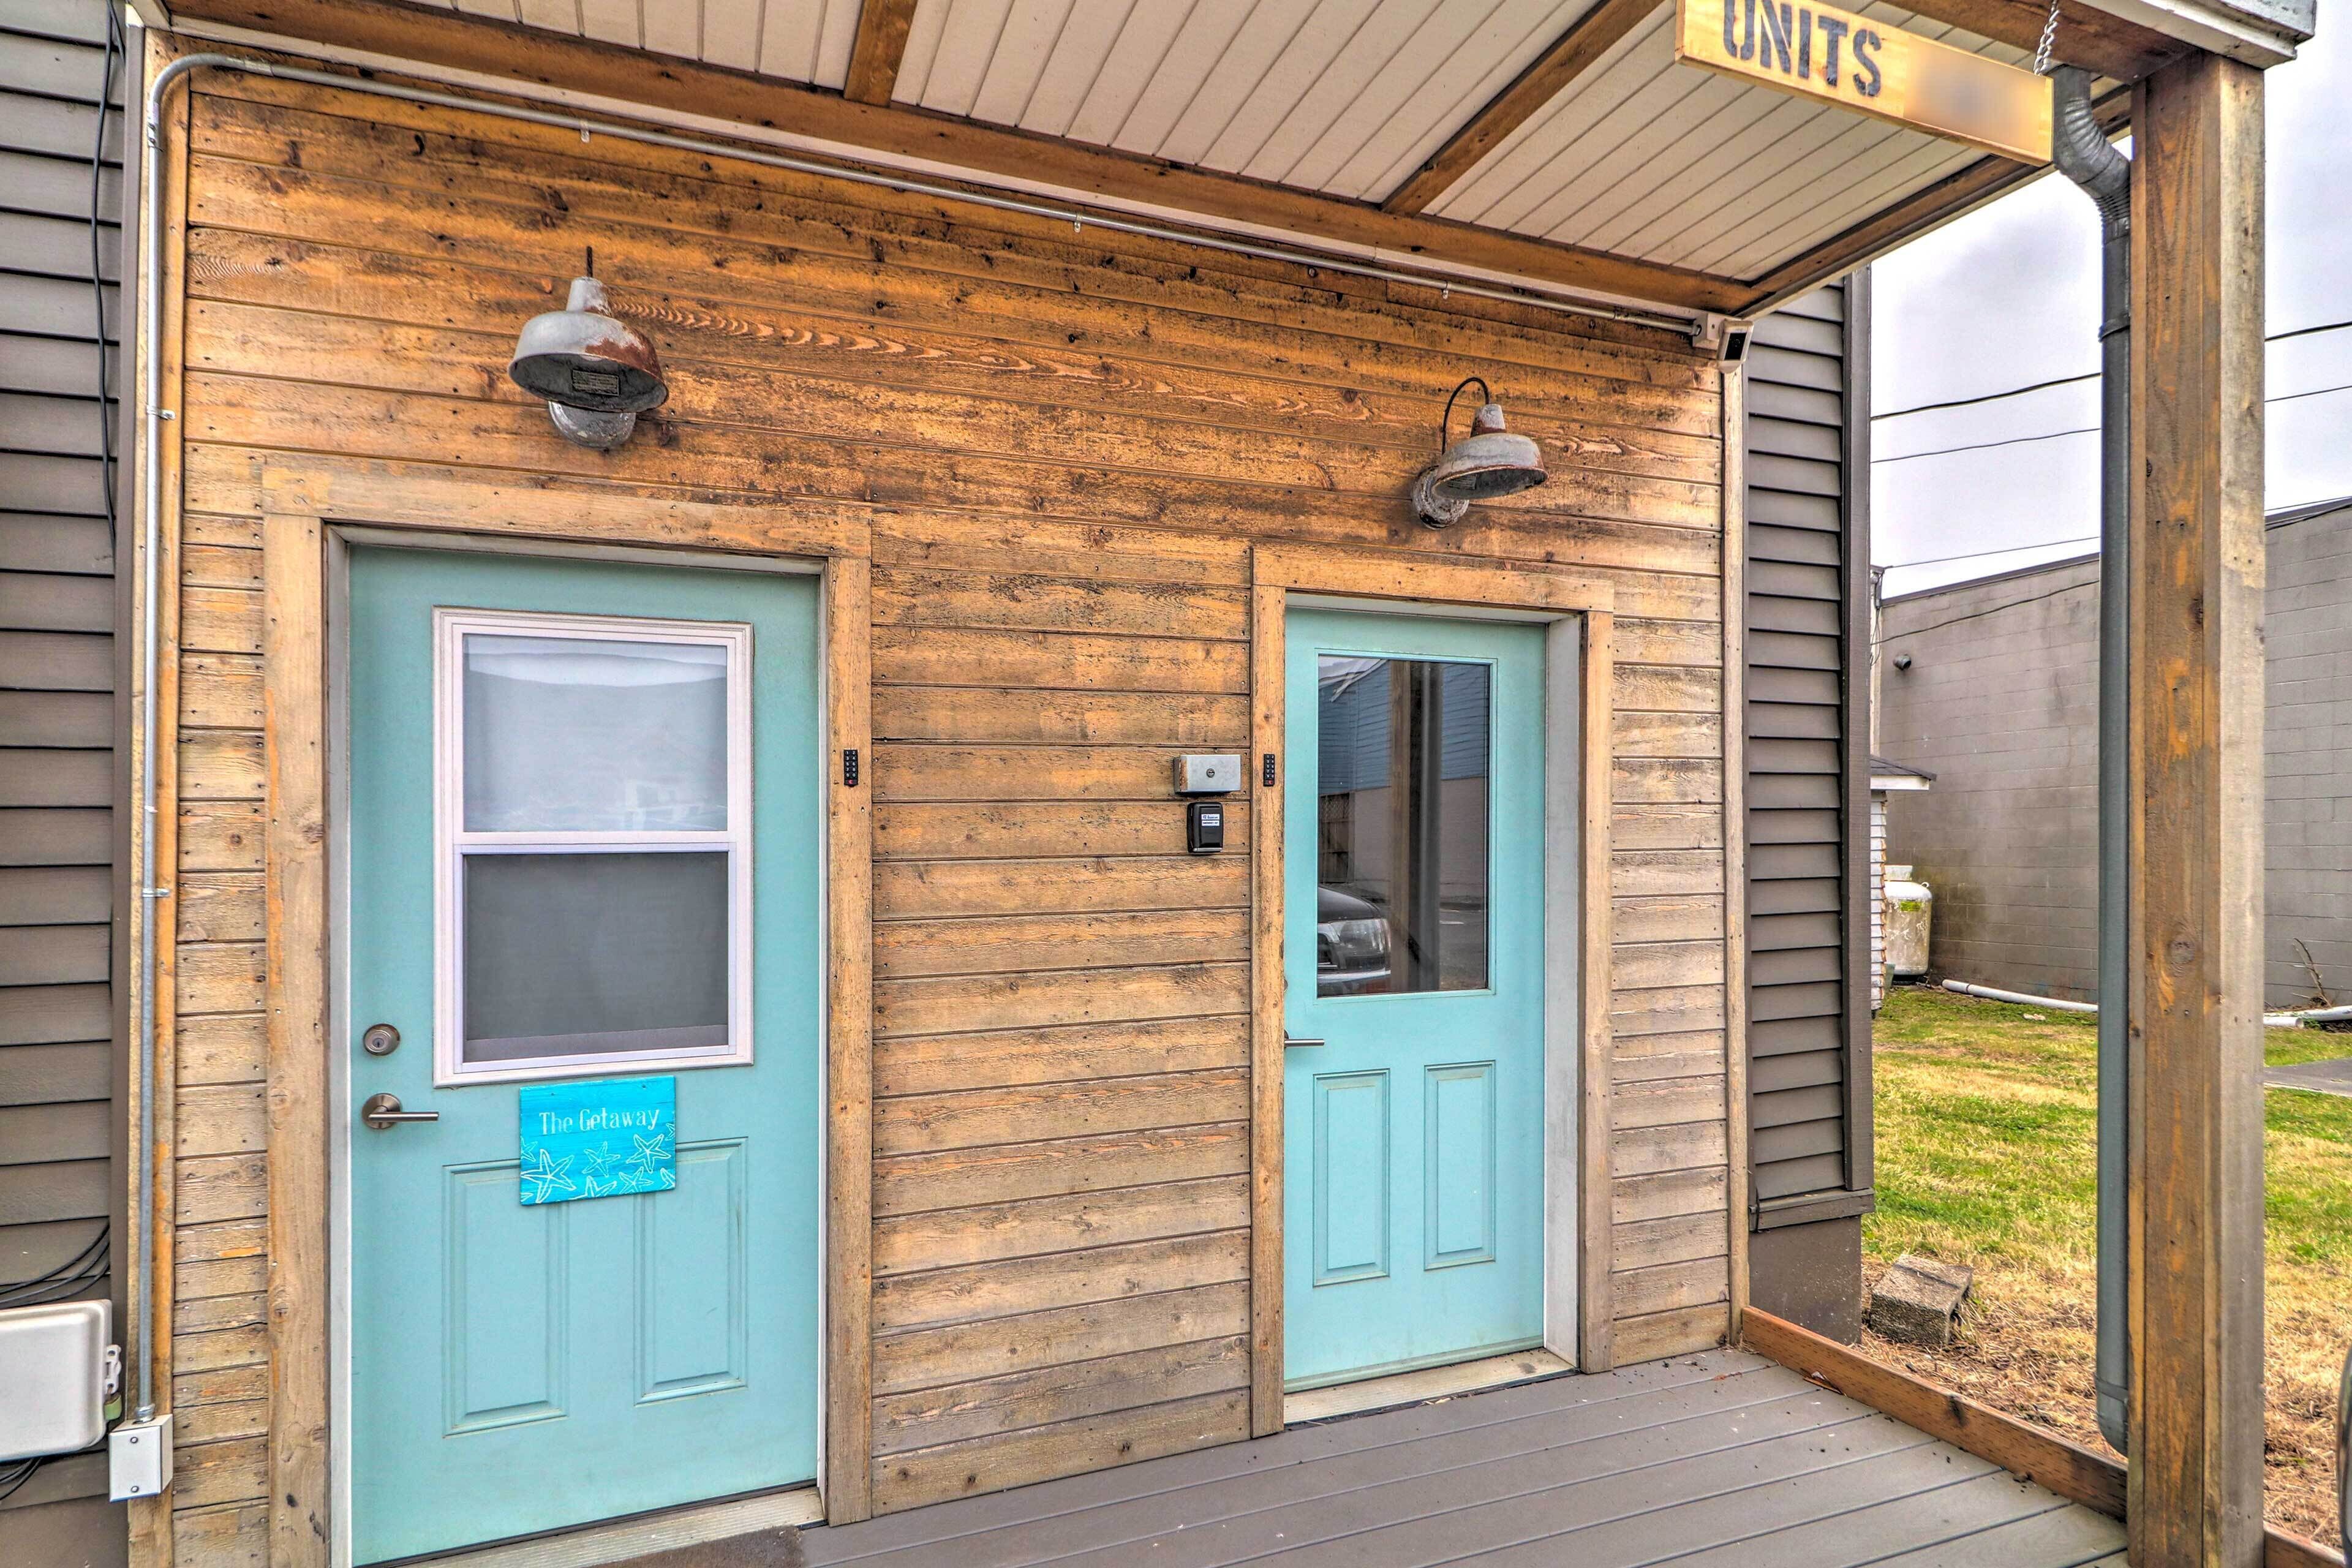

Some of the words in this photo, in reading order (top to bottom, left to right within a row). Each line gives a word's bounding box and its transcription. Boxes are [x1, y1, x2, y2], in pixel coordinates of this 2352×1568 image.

[1723, 0, 1882, 98] UNITS
[539, 1112, 573, 1135] The
[579, 1107, 660, 1132] Getaway
